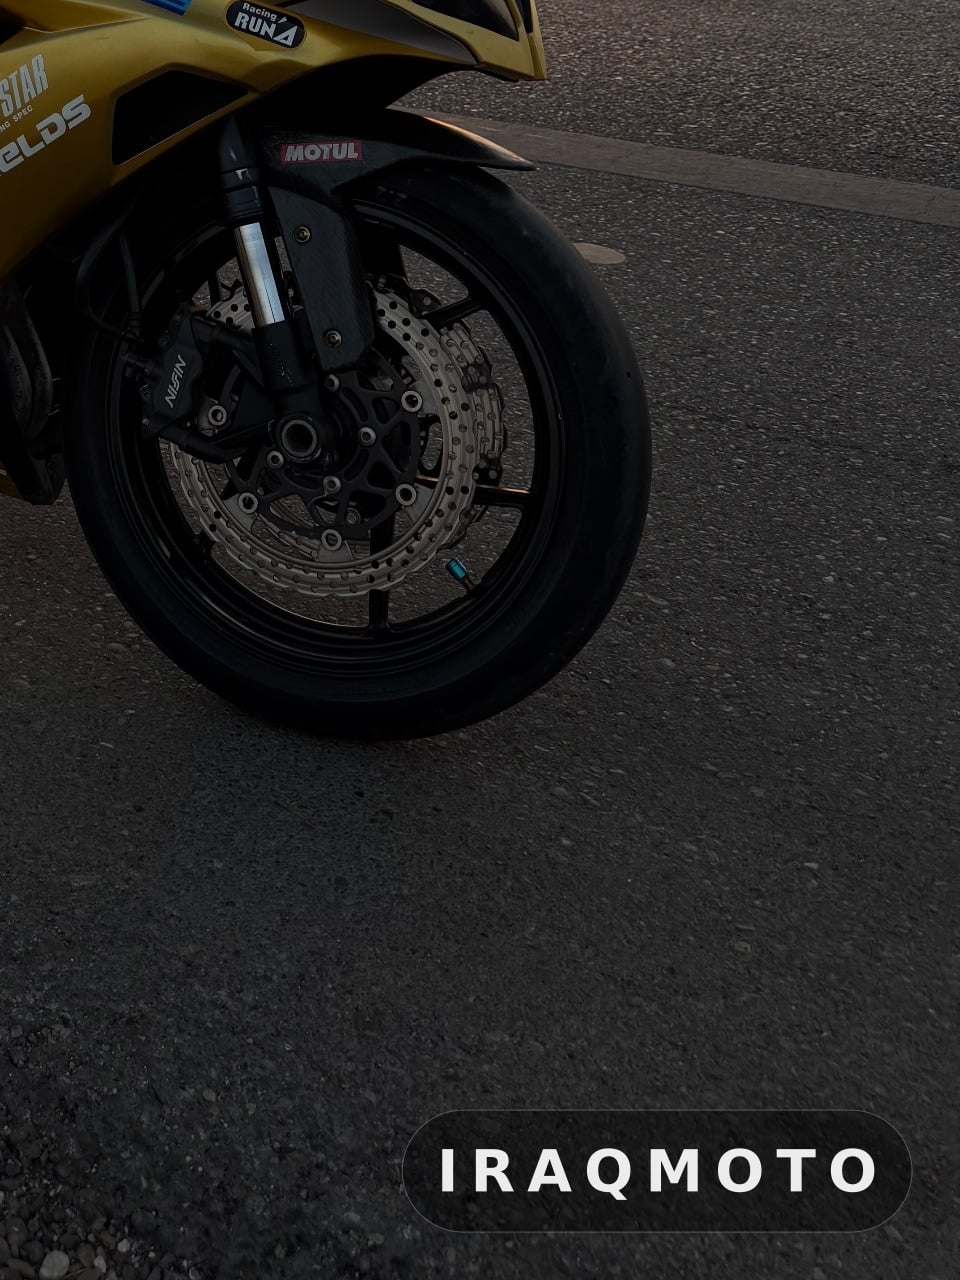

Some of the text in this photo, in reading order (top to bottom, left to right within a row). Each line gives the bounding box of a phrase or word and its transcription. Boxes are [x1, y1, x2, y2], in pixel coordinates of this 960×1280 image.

[242, 2, 279, 21] Racing
[12, 104, 33, 122] SPEC
[284, 142, 359, 162] MOTUL
